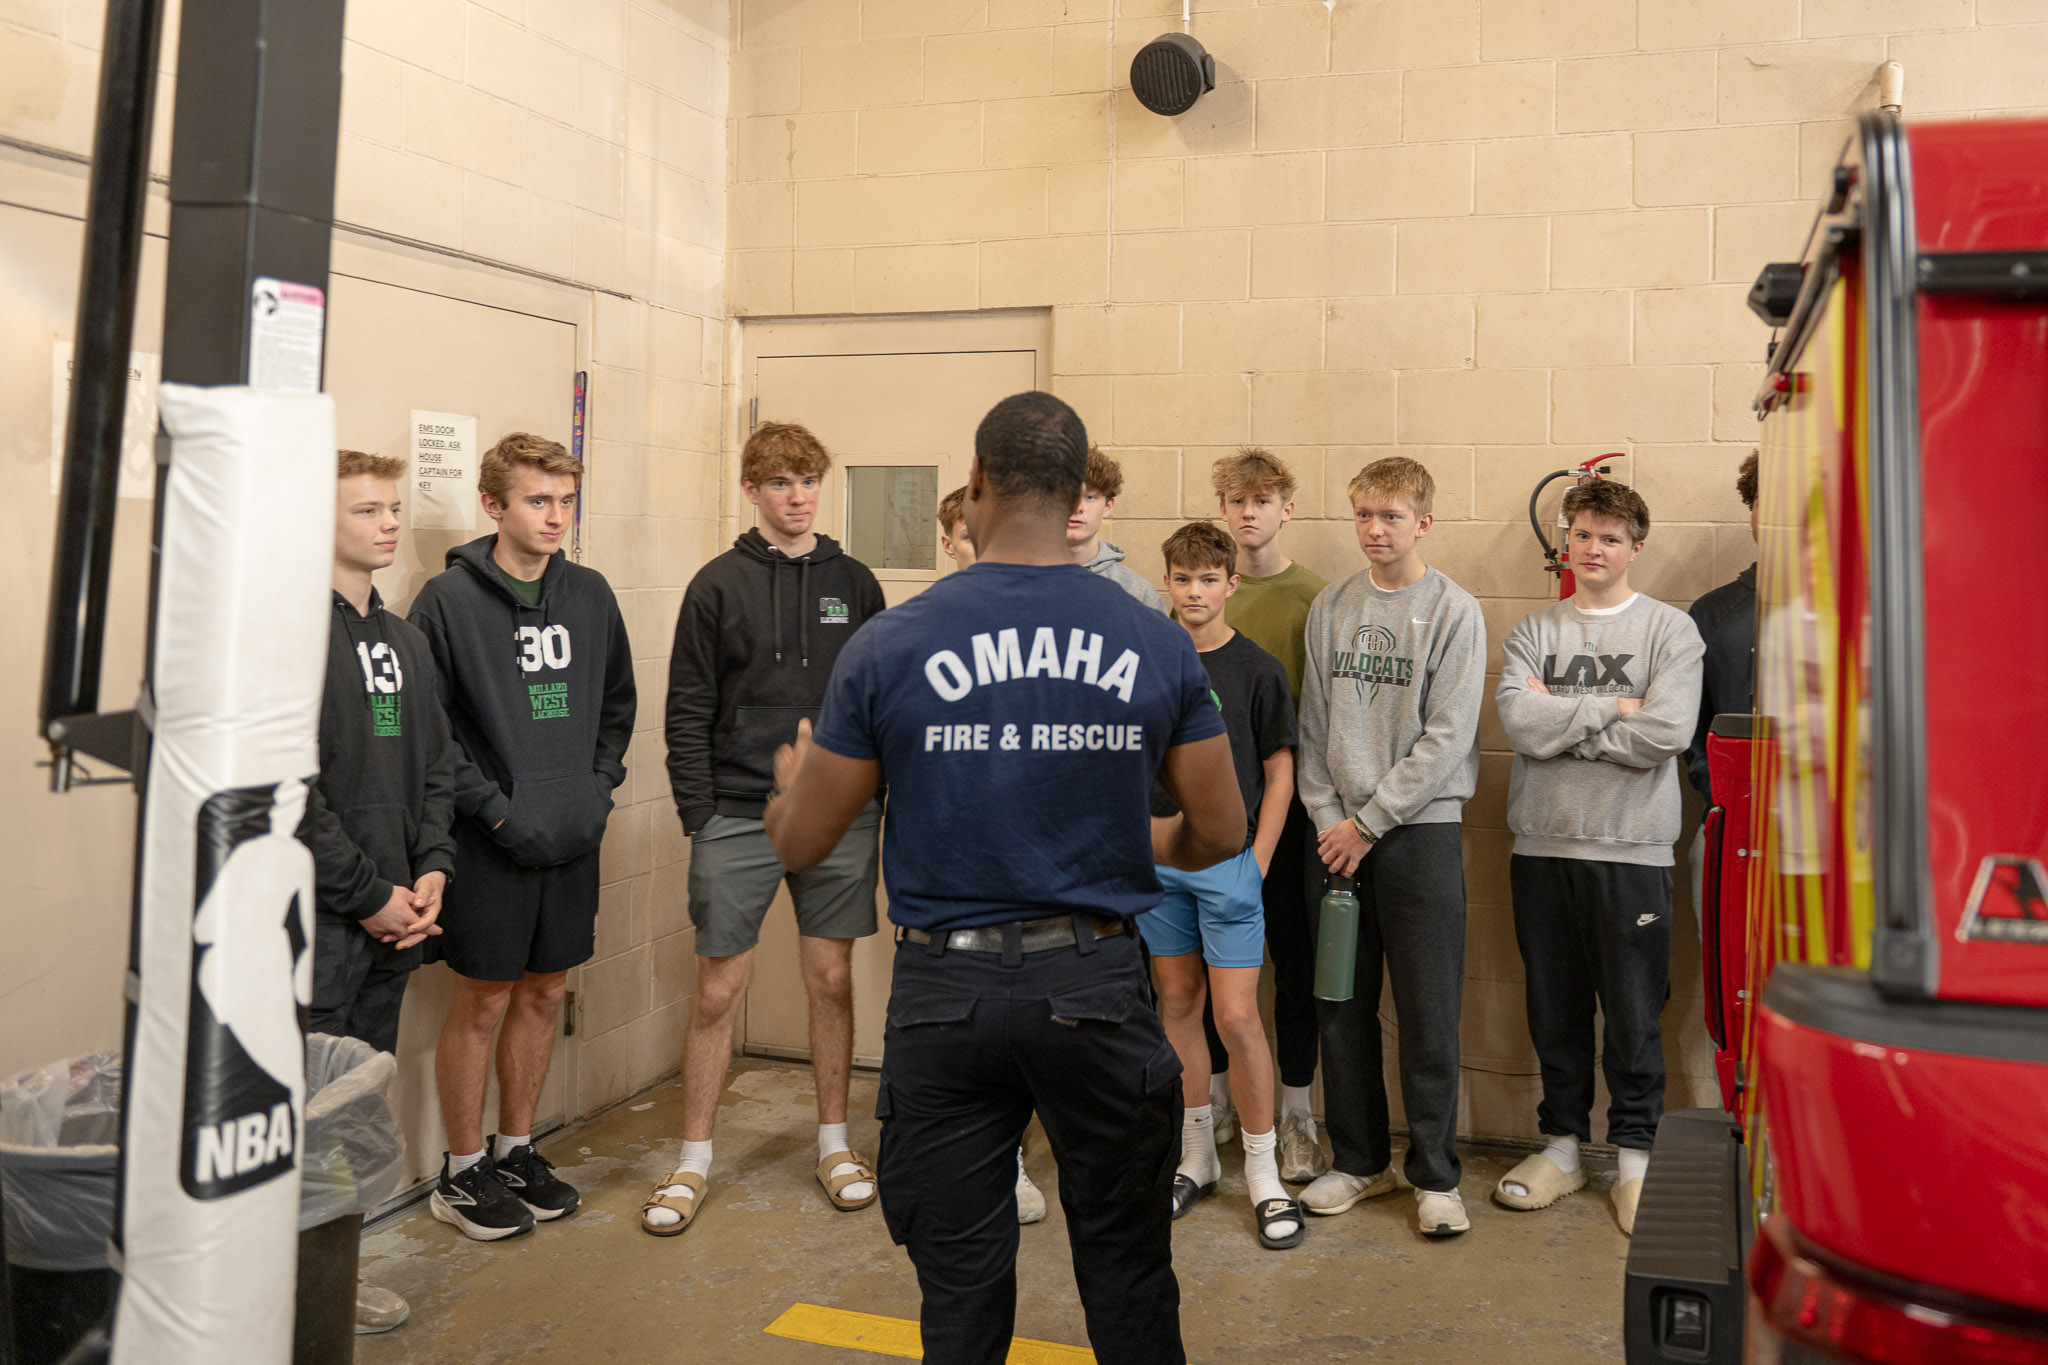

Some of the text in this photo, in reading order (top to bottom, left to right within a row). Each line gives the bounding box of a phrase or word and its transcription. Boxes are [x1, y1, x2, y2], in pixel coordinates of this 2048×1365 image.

[419, 424, 455, 434] EMS DOOR
[448, 441, 461, 449] ASK
[419, 453, 442, 461] HOUSE
[419, 467, 462, 477] CAPTAIN FOR
[419, 481, 432, 490] KEY
[519, 624, 571, 672] 30
[356, 641, 403, 693] 13
[924, 627, 1140, 703] OMAHA
[1543, 653, 1636, 687] LAX
[1337, 671, 1410, 688] ACROSSE
[528, 682, 568, 695] MILLARD
[529, 692, 568, 711] WEST
[532, 708, 570, 720] LACROSSE
[924, 723, 1143, 752] FIRE & RESCUE
[195, 1101, 293, 1184] NBA
[1268, 1200, 1290, 1211] NIKE
